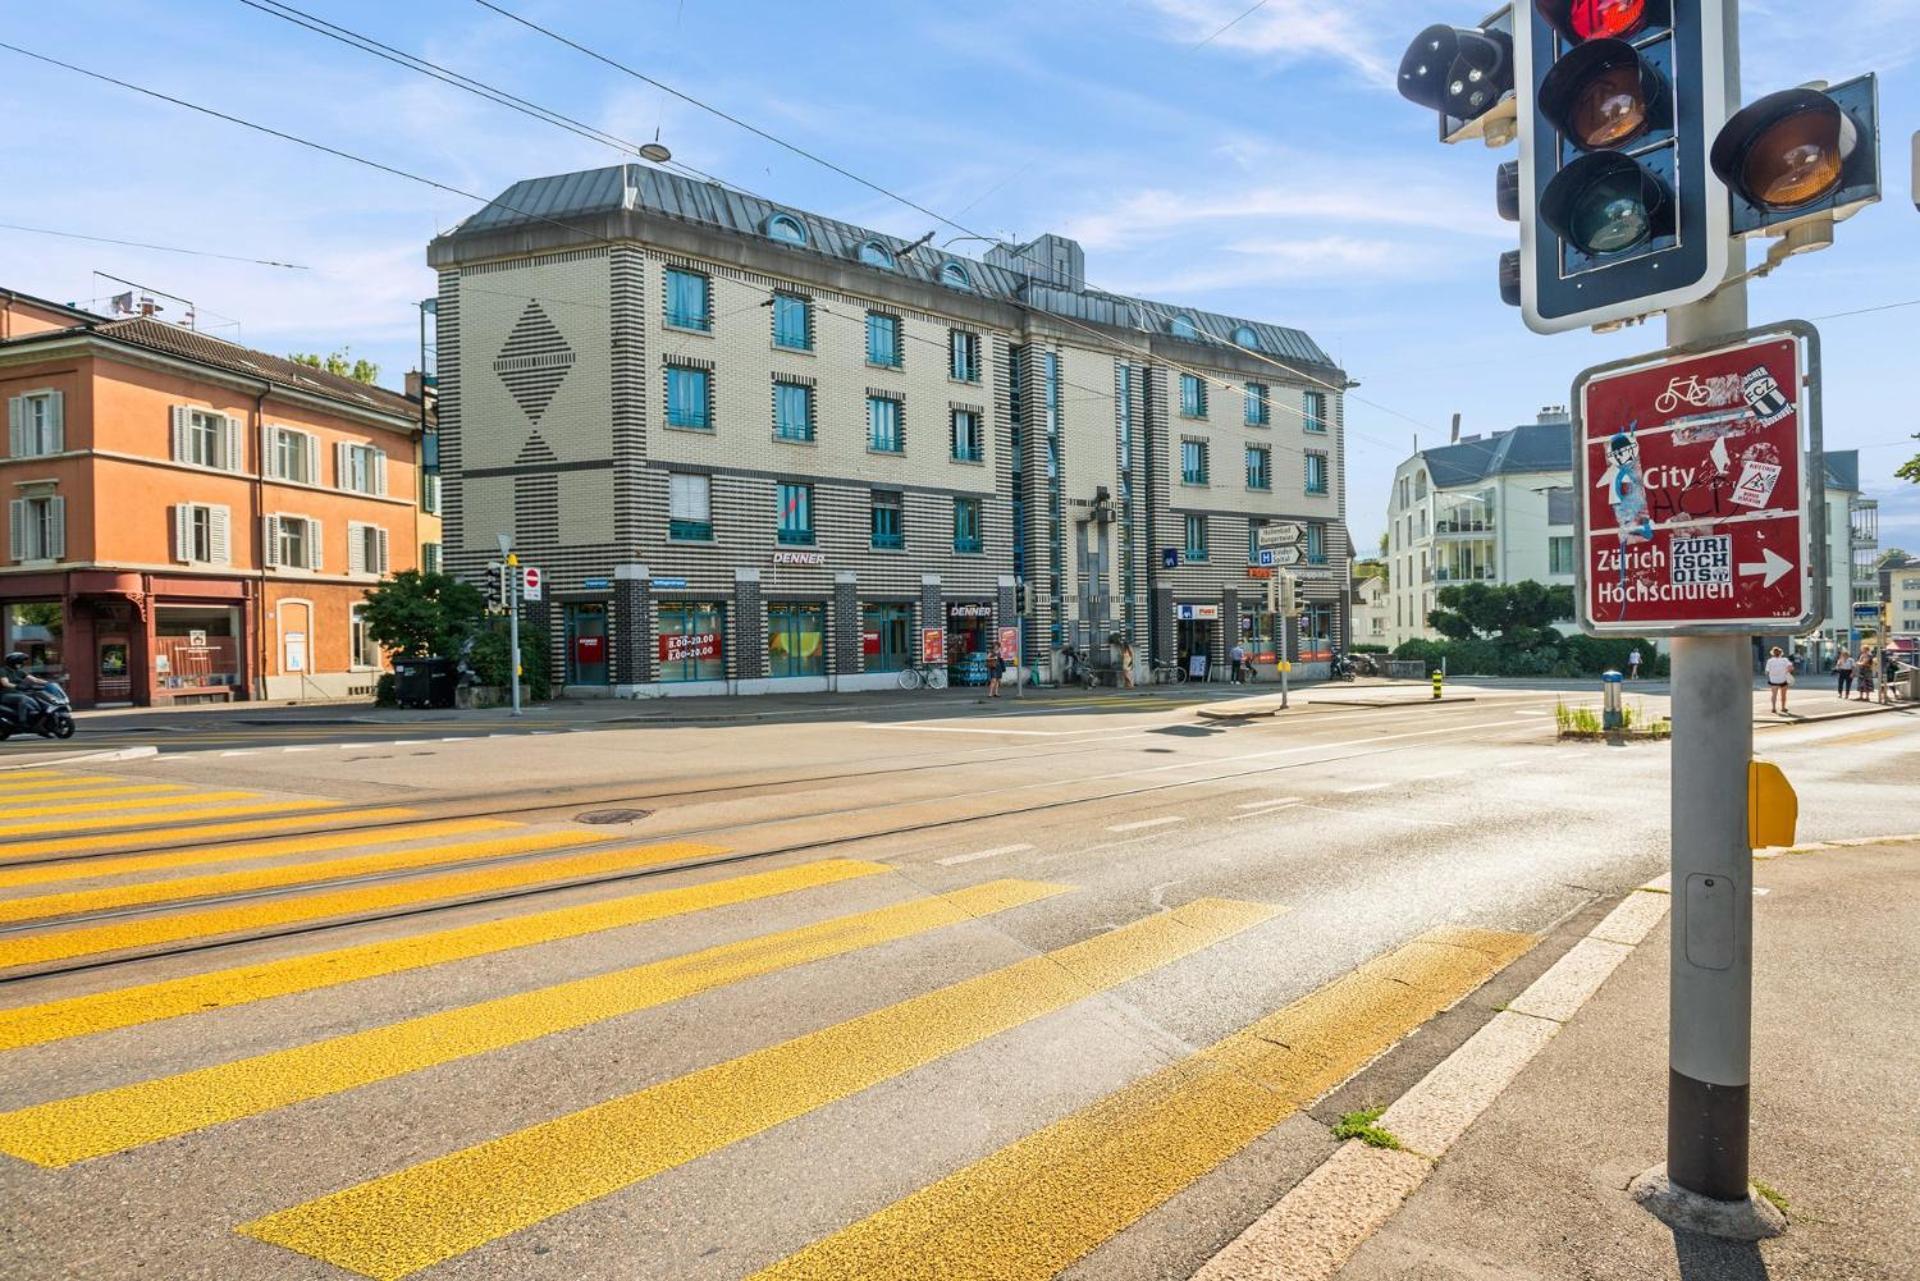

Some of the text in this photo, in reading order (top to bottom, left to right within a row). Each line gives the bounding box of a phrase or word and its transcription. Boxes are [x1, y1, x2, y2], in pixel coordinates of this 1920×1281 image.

[1745, 379, 1774, 402] FCZ
[1643, 465, 1695, 492] City
[773, 552, 825, 564] DENNER
[1597, 545, 1665, 571] Zürich
[1674, 553, 1728, 570] ISCH
[1674, 569, 1711, 582] OIS
[1598, 579, 1734, 603] Hochschulen
[951, 607, 991, 616] DENNER
